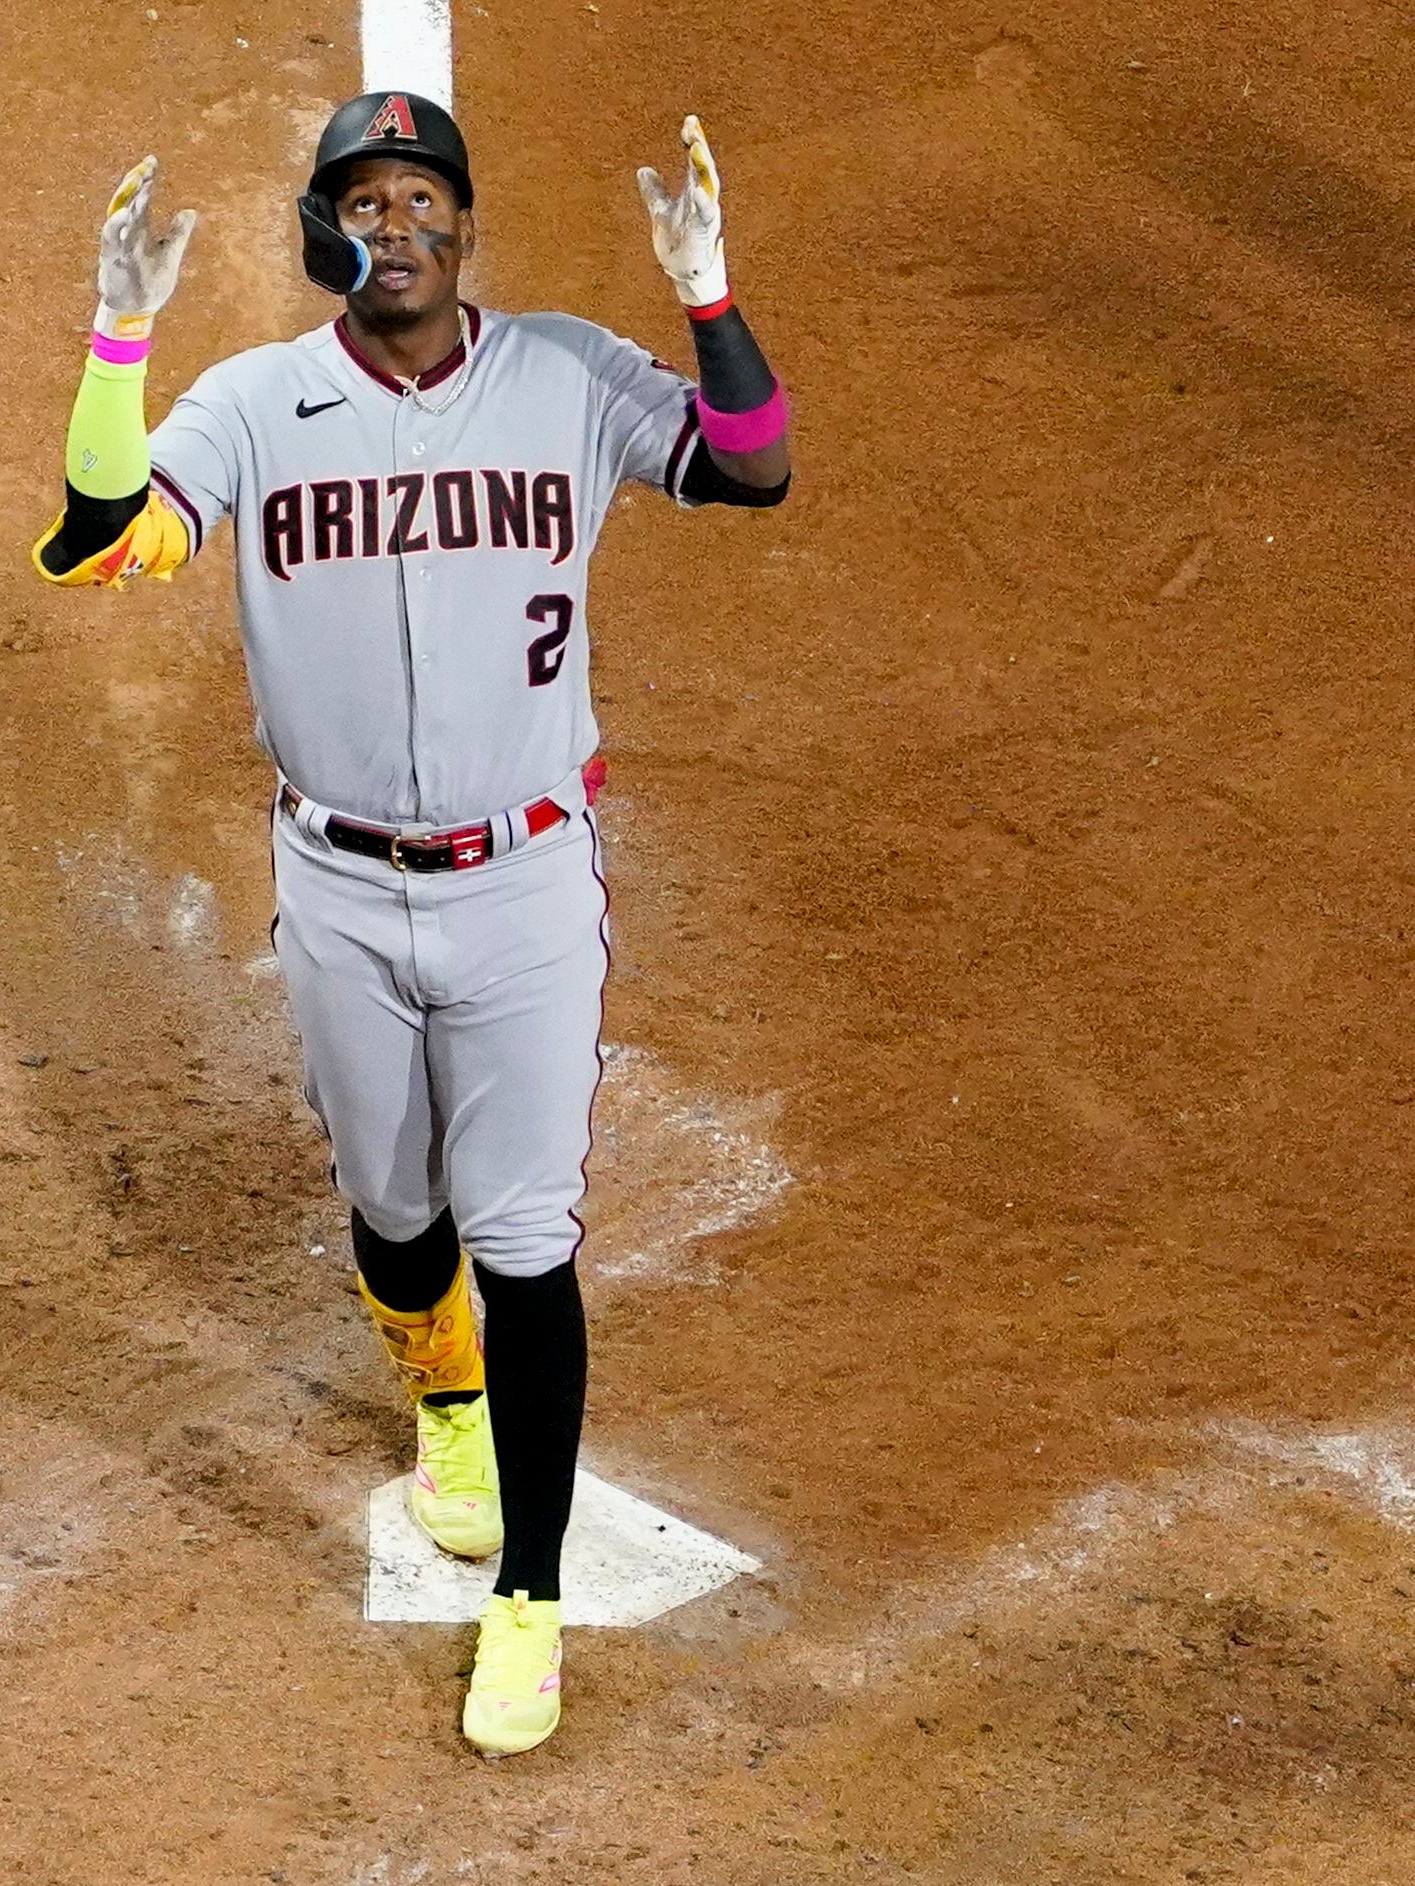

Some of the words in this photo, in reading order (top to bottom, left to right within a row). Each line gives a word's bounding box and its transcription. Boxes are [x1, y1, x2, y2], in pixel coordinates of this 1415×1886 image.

[361, 95, 418, 141] A
[261, 468, 575, 583] ARIZONA
[525, 592, 574, 688] 2
